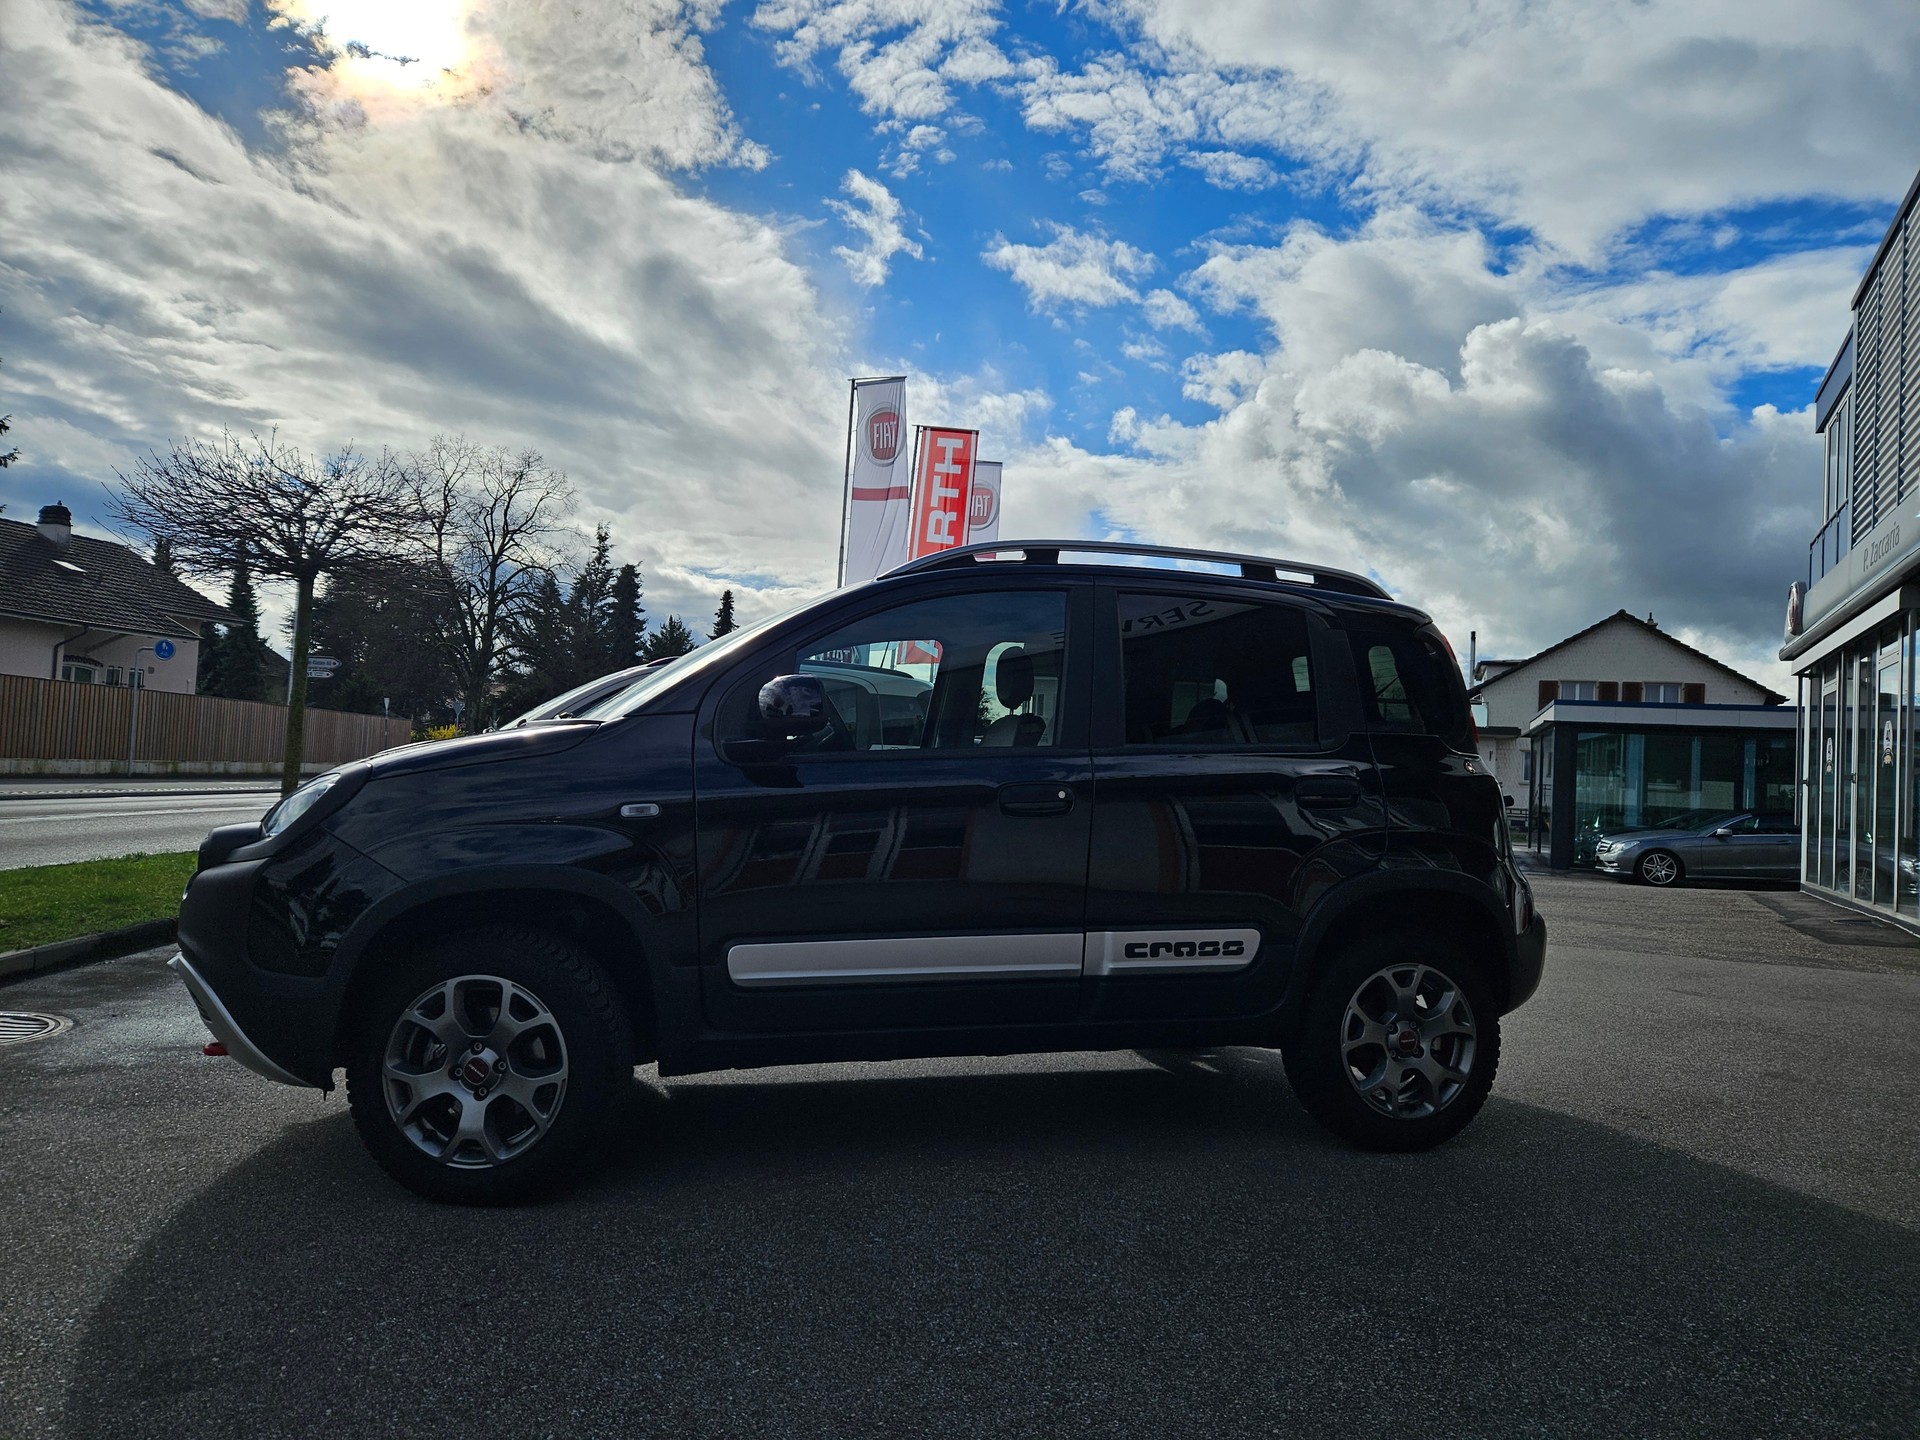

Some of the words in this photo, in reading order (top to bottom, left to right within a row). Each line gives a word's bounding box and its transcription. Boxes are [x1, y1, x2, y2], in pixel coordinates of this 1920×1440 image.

[873, 421, 897, 450] FIAT
[926, 437, 963, 545] RTH
[1124, 940, 1245, 959] cross
